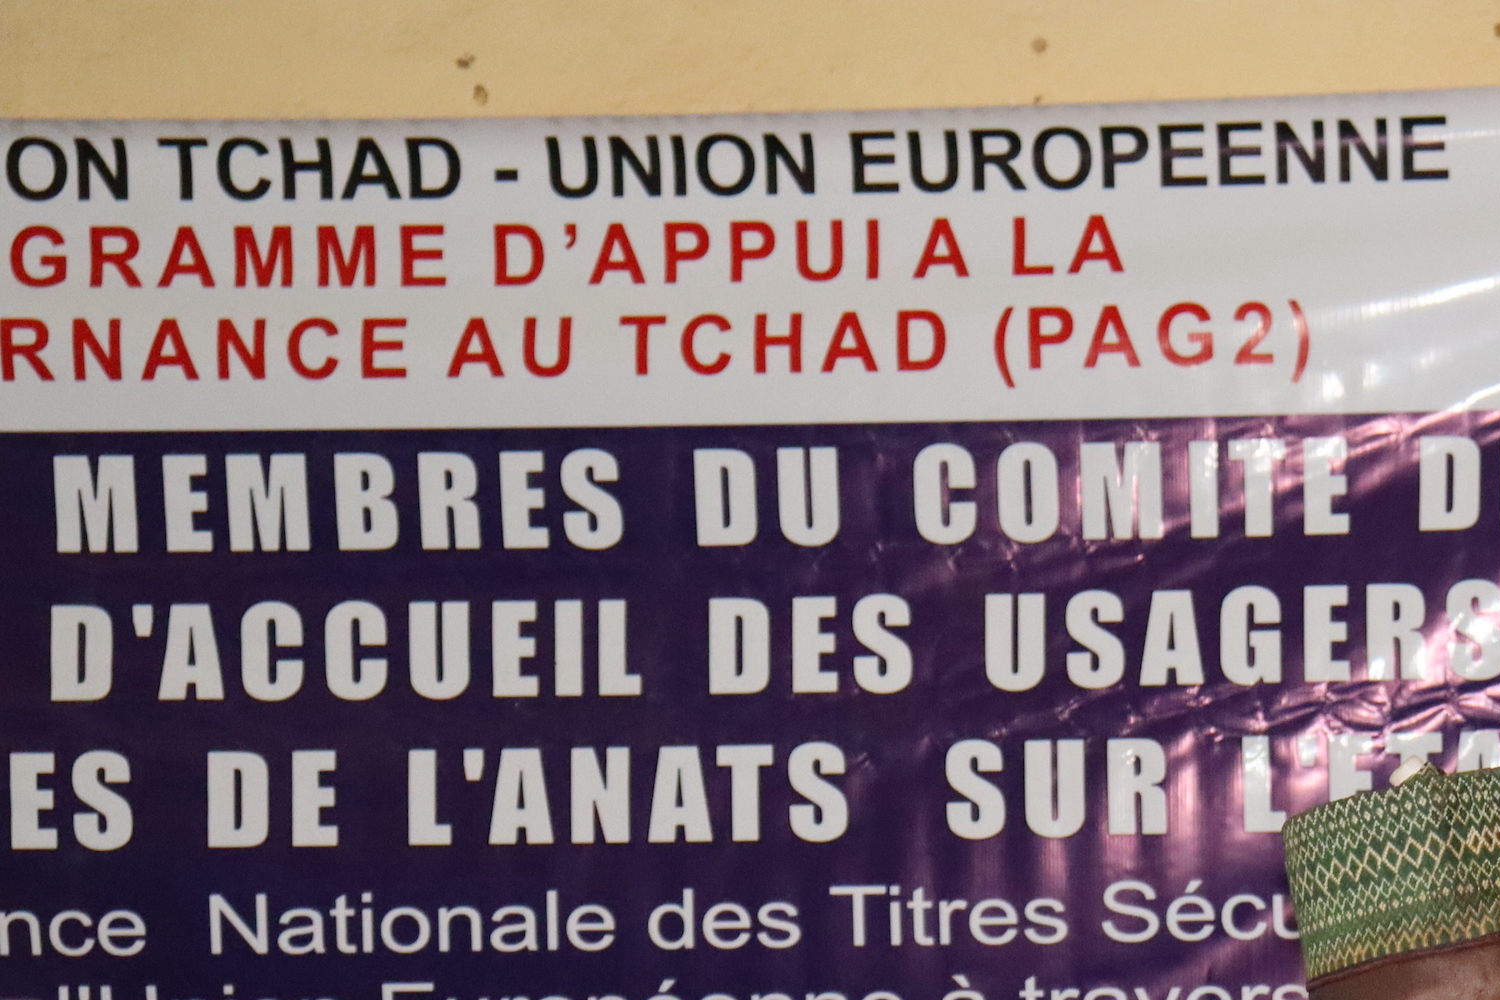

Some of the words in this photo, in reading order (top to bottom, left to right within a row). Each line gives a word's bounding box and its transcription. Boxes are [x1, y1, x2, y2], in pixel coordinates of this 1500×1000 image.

[4, 134, 131, 204] ON
[155, 134, 465, 202] TCHAD
[542, 130, 818, 198] UNION
[849, 115, 1450, 195] EUROPEENNE
[8, 222, 450, 291] GRAMME
[912, 215, 972, 280] A
[1009, 212, 1126, 277] LA
[0, 316, 410, 382] RNANCE
[445, 314, 575, 380] AU
[616, 308, 948, 378] TCHAD
[992, 299, 1310, 389] (PAG2)
[50, 446, 626, 554] MEMBRES
[692, 444, 843, 548] DU
[911, 440, 1351, 545] COMITE
[47, 600, 644, 702] D'ACCUEIL
[706, 592, 914, 696] DES
[7, 748, 134, 852] ES
[205, 748, 340, 850] DE
[405, 740, 850, 848] L'ANATS
[943, 736, 1170, 842] SUR
[206, 888, 618, 958] Nationale
[645, 886, 802, 954] des
[828, 880, 1070, 950] Titres
